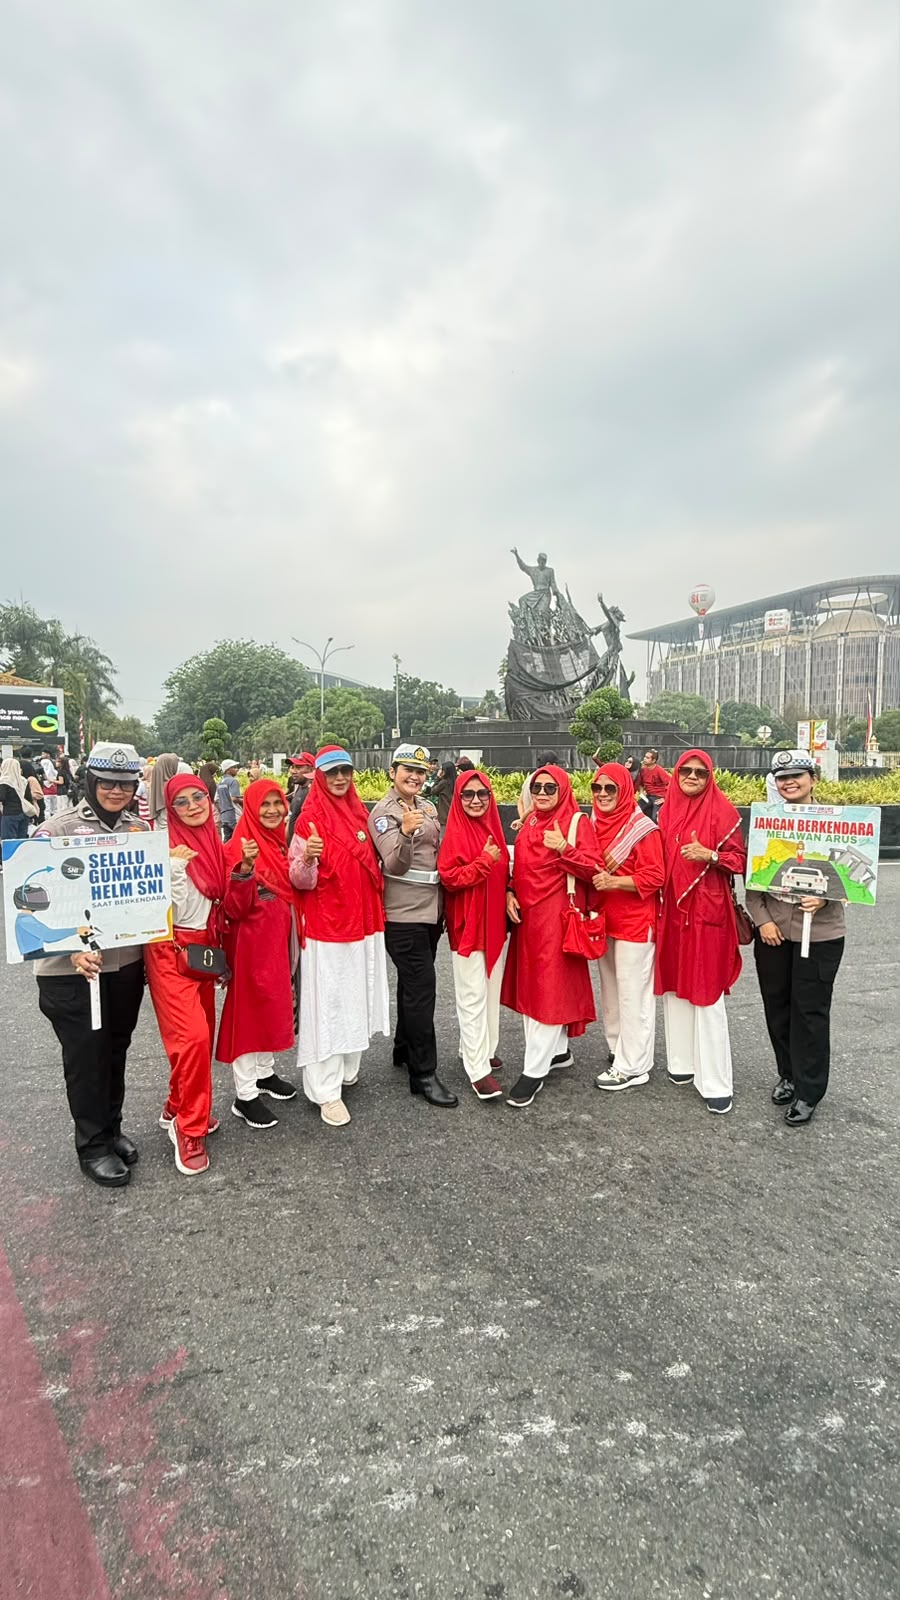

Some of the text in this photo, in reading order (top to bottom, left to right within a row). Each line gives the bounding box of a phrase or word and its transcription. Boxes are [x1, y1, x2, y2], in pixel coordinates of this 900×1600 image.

[754, 817, 874, 836] JANGAN BERKENDARA
[766, 830, 858, 844] MELAWAN ARUS
[88, 850, 144, 868] SELALU
[89, 864, 164, 884] GUNAKAN
[92, 880, 163, 900] HELM SNI
[115, 895, 167, 906] BERKENDARA
